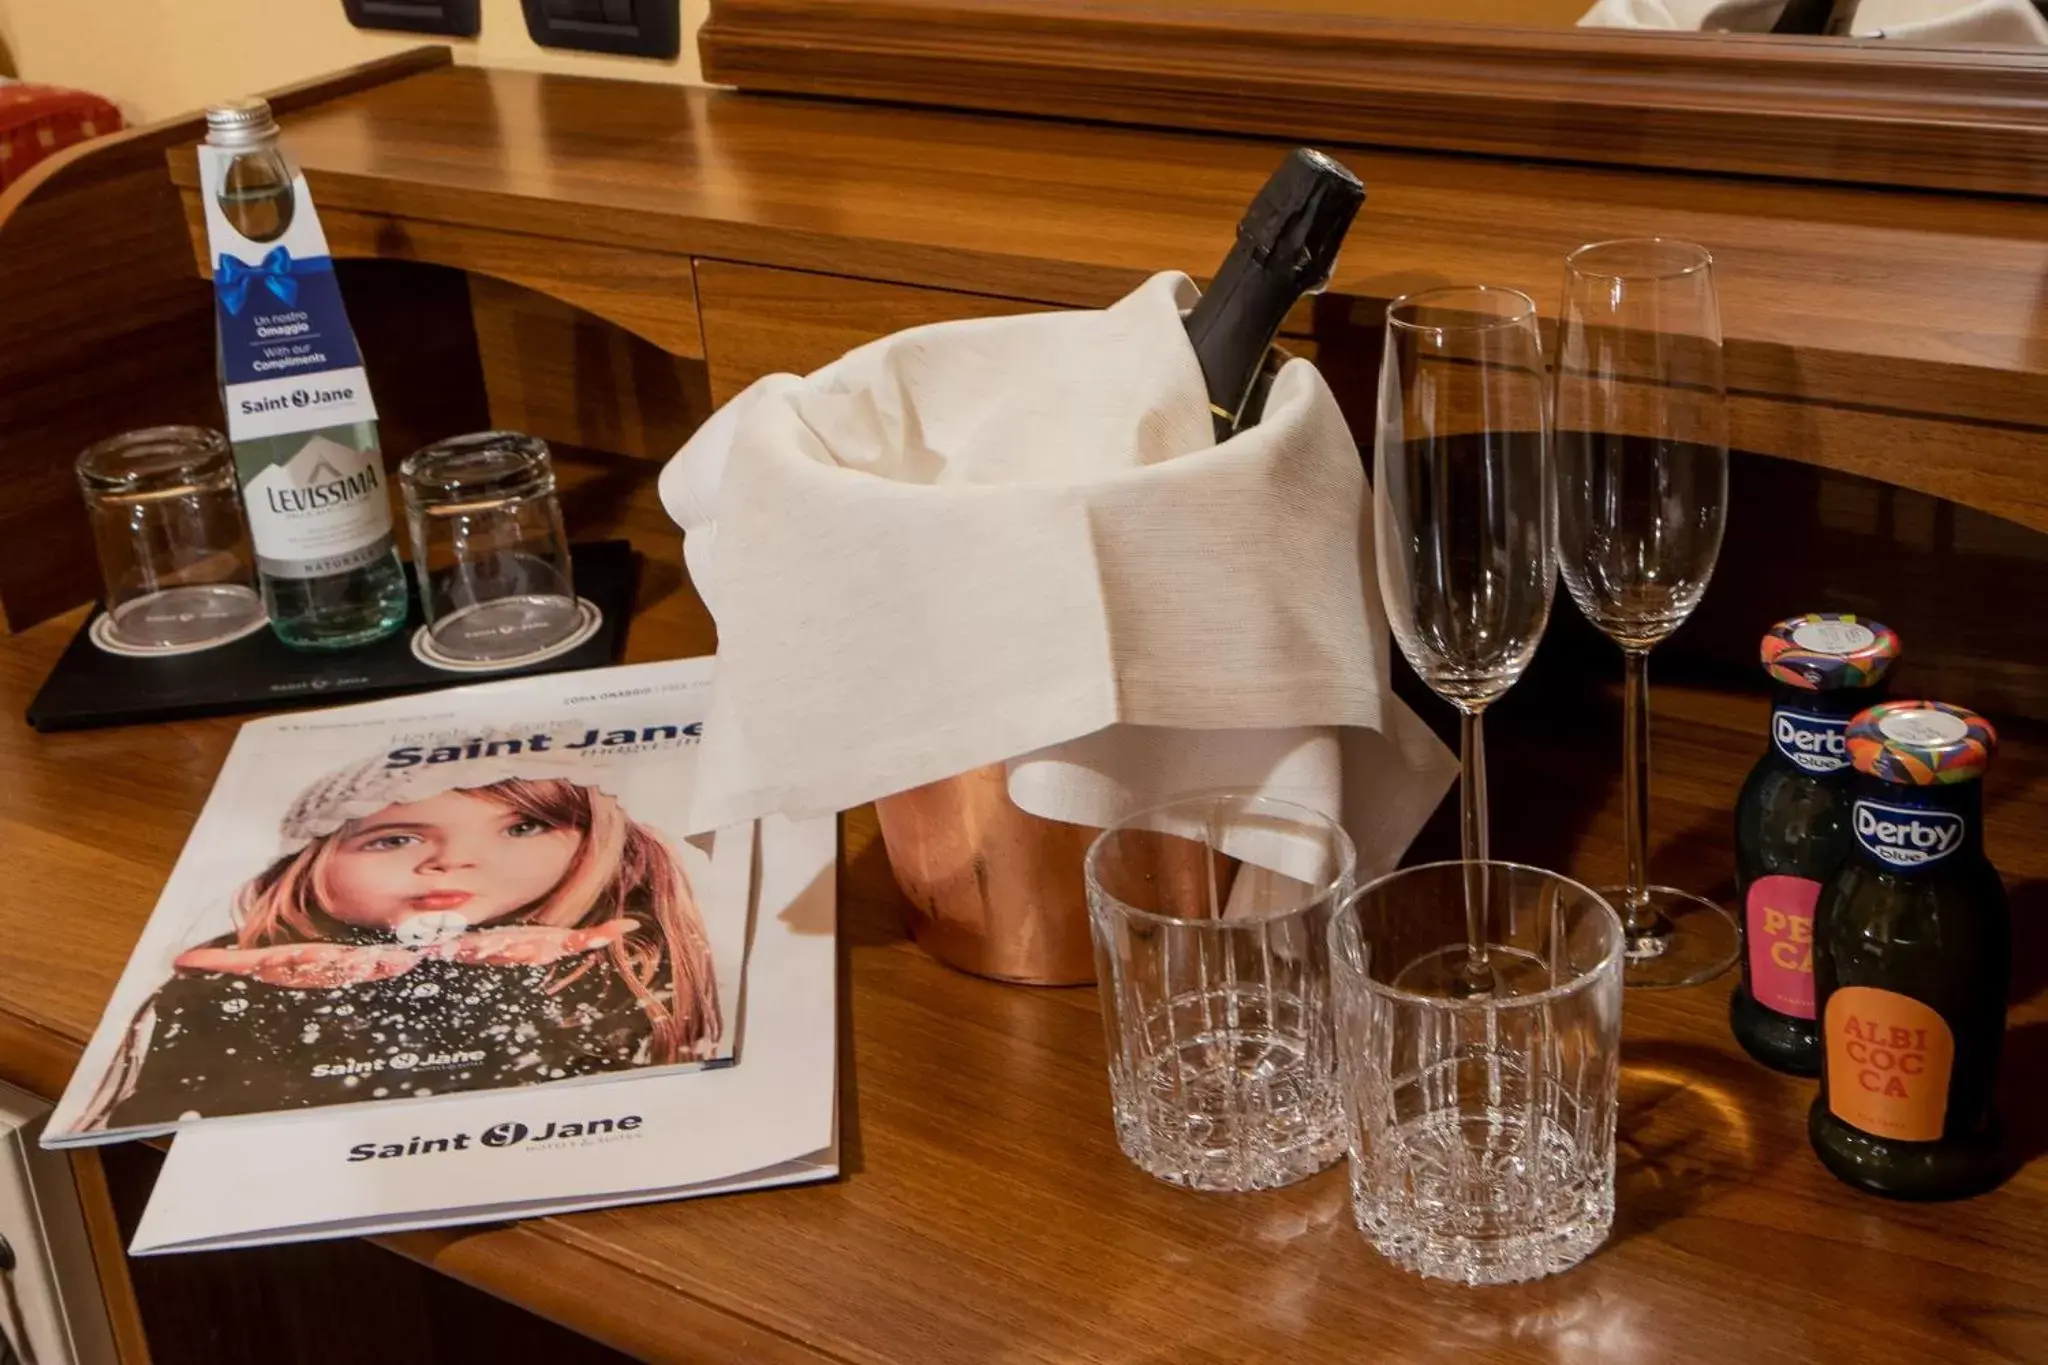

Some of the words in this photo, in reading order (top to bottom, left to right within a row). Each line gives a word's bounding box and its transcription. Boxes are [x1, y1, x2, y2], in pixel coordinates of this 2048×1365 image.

[257, 321, 310, 337] Omaggio
[272, 311, 308, 323] nostro
[252, 352, 327, 372] Compliments
[263, 346, 290, 358] With
[292, 344, 311, 354] our
[241, 395, 289, 415] Saint
[312, 388, 354, 405] Jane
[265, 463, 379, 514] LEVISSIMA
[384, 733, 553, 769] Saint
[564, 721, 704, 750] Jane
[1778, 717, 1846, 754] Derb
[1798, 754, 1837, 769] blue
[1858, 806, 1957, 851] Derby
[1879, 847, 1923, 862] blue
[1762, 907, 1813, 944] PE
[1844, 1014, 1928, 1051] ALBI
[310, 1058, 387, 1078] Saint
[418, 1050, 487, 1066] Jane
[1846, 1041, 1925, 1075] COC
[1857, 1069, 1909, 1099] CA
[346, 1133, 471, 1162] Saint
[530, 1115, 643, 1142] Jane
